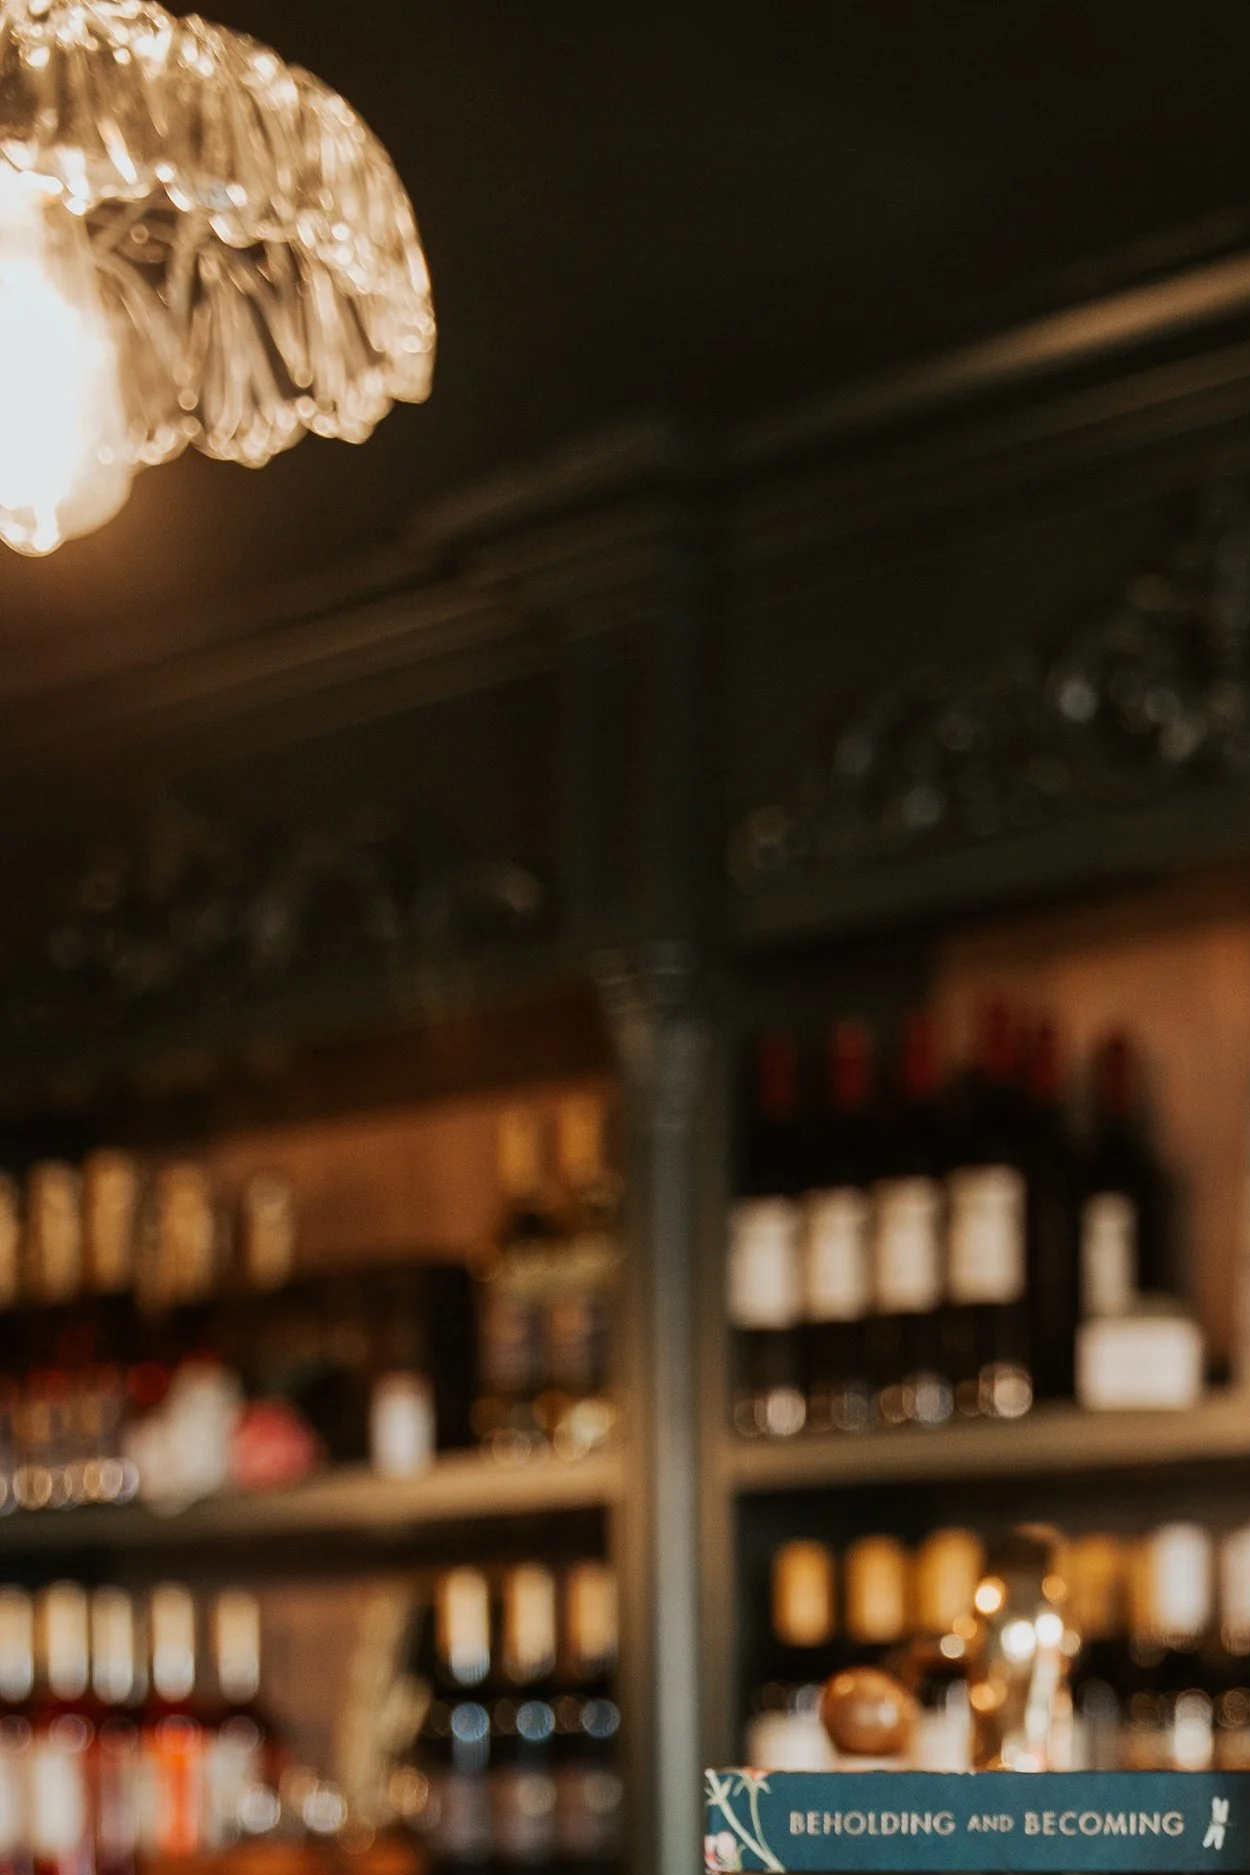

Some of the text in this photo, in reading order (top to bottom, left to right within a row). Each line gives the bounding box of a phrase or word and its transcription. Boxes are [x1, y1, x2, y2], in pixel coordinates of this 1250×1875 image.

[788, 1811, 956, 1836] BEHOLDING
[966, 1814, 1015, 1833] AND
[1024, 1811, 1185, 1836] BECOMING
